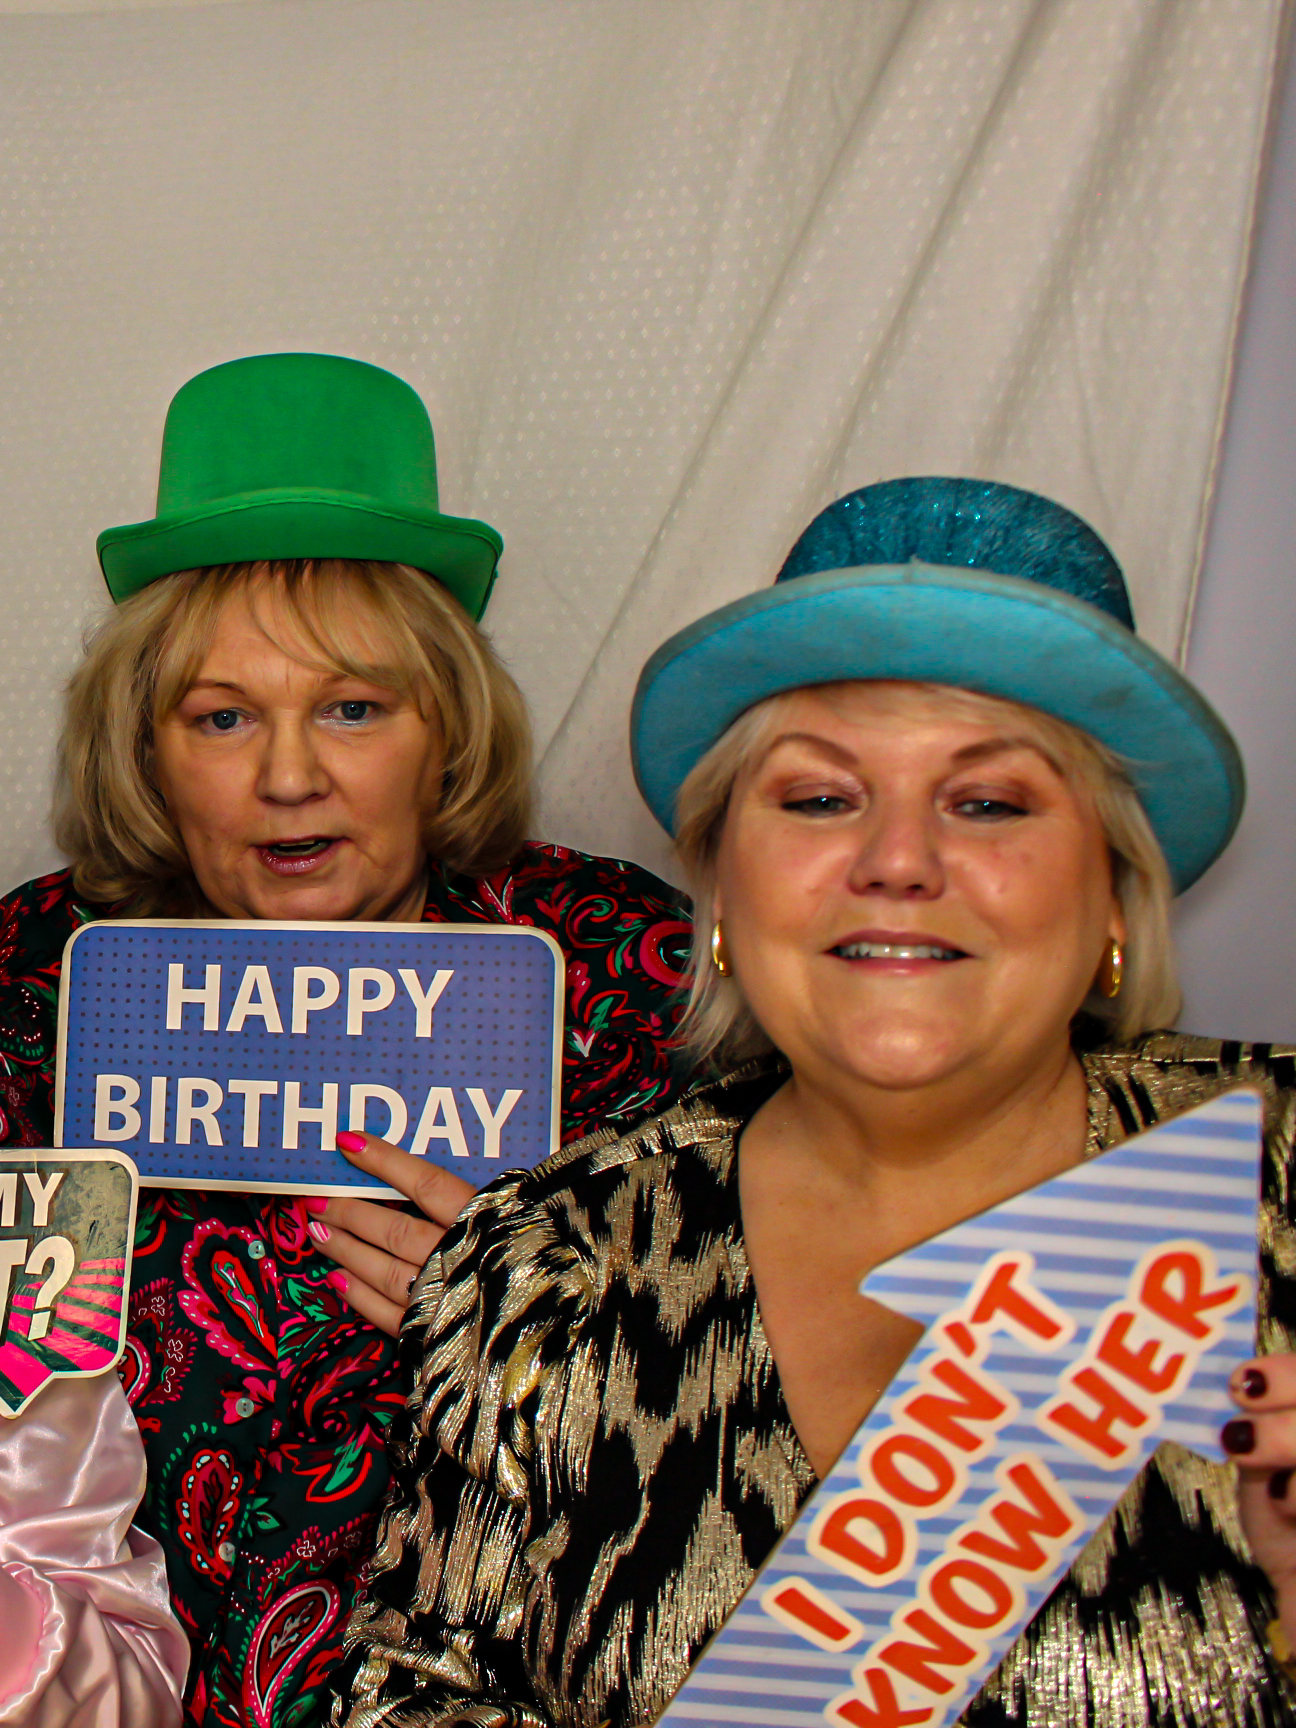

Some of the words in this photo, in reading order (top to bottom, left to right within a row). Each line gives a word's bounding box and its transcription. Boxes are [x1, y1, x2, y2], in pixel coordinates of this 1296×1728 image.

[93, 1074, 523, 1159] BIRTHDAY
[166, 963, 455, 1038] HAPPY
[774, 1587, 851, 1642] I
[819, 1262, 1063, 1576] DON'T
[835, 1463, 1075, 1728] KNOW
[1047, 1251, 1241, 1458] HER
